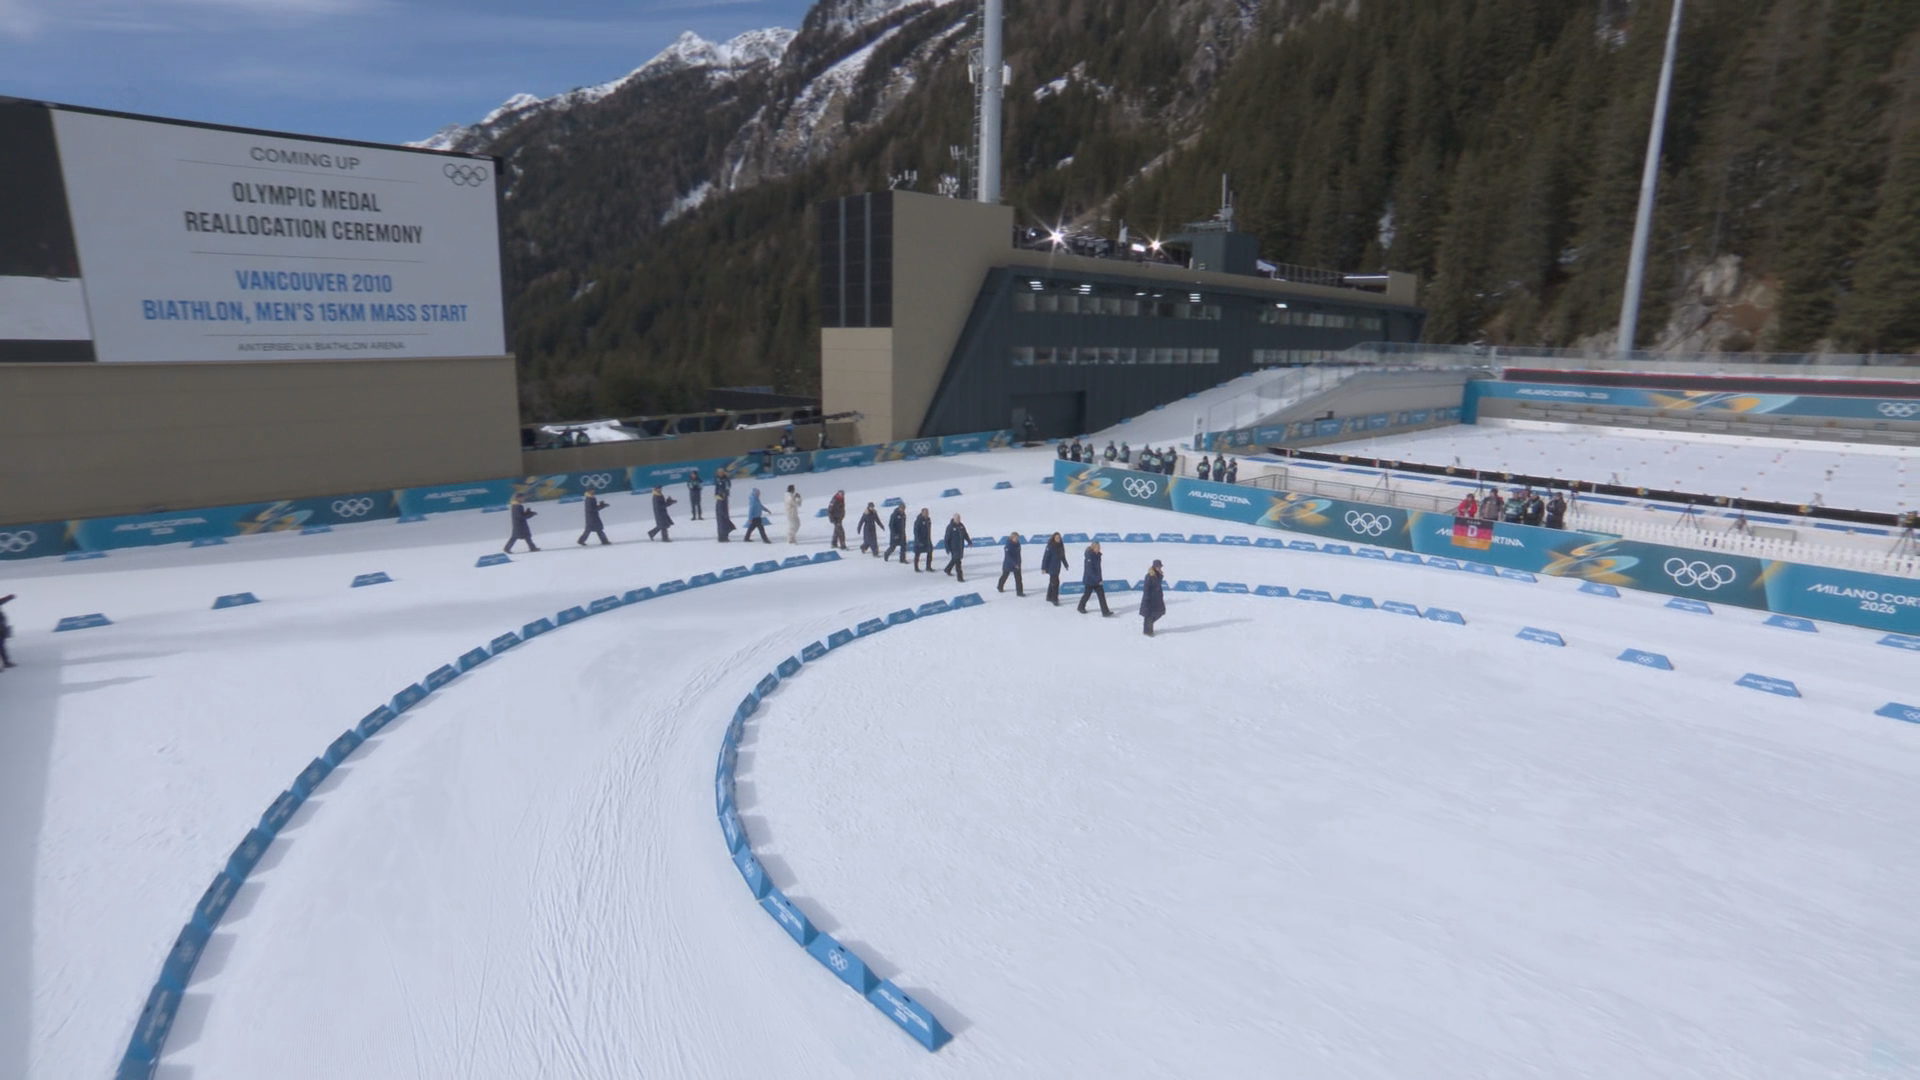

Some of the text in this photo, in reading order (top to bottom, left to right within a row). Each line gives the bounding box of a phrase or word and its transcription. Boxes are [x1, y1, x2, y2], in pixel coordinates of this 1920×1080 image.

[250, 147, 361, 170] COMING UP
[232, 181, 381, 213] OLYMPIC MEDAL
[184, 211, 423, 244] REALLOCATION CEREMONY
[235, 269, 393, 293] VANCOUVER 2010
[142, 299, 468, 324] BIATHLON, MEN'S 15KM MASS START
[238, 342, 405, 351] ANTERSELVA BIATHLON ARENA
[1467, 525, 1478, 537] D
[1806, 583, 1878, 601] MILANO
[1859, 600, 1897, 614] 2026
